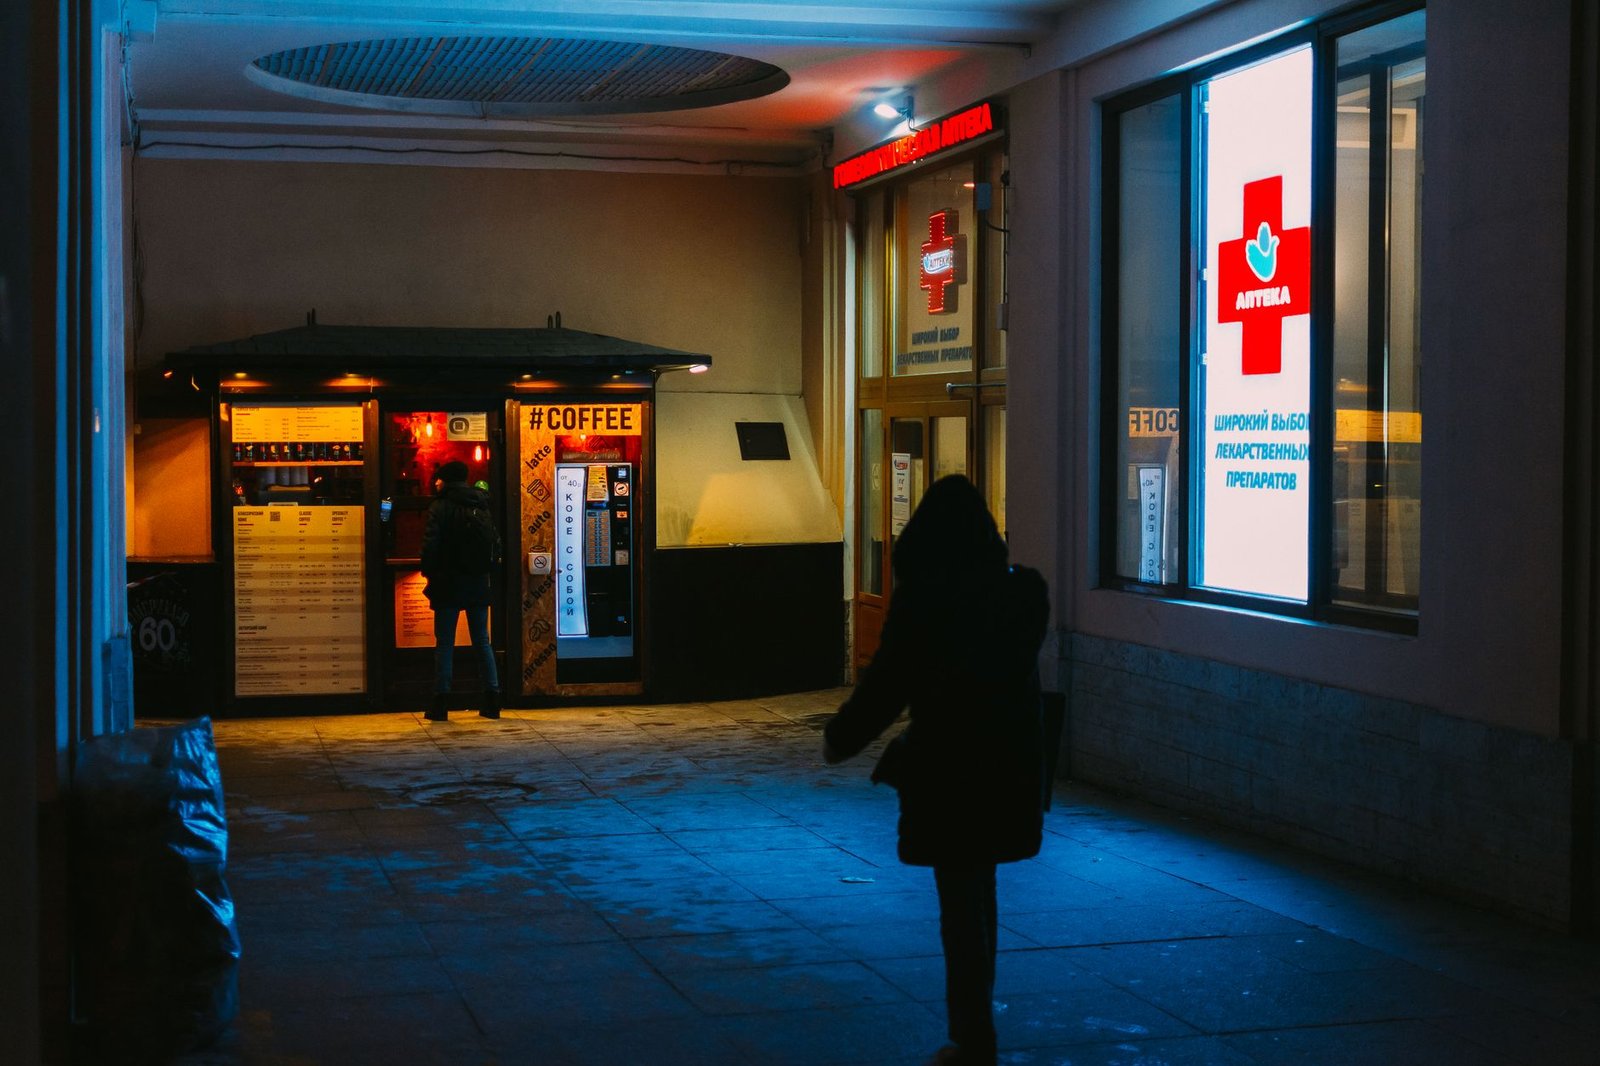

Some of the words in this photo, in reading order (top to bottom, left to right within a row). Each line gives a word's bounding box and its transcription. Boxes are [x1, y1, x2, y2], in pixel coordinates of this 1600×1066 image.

[941, 102, 993, 148] АПТЕКА
[1235, 285, 1291, 311] АПТЕКА
[529, 407, 633, 431] #COFFEE
[1214, 408, 1269, 431] ШИРОКИЙ
[525, 444, 552, 470] latte
[1215, 442, 1309, 461] ЛЕКАРСТВЕННЫХ
[1226, 471, 1297, 490] ПРЕПАРАТОВ
[528, 510, 551, 535] auto
[565, 493, 574, 535] КОФЕ
[566, 546, 573, 554] С
[566, 563, 574, 616] СОБОЙ
[139, 616, 176, 652] 60
